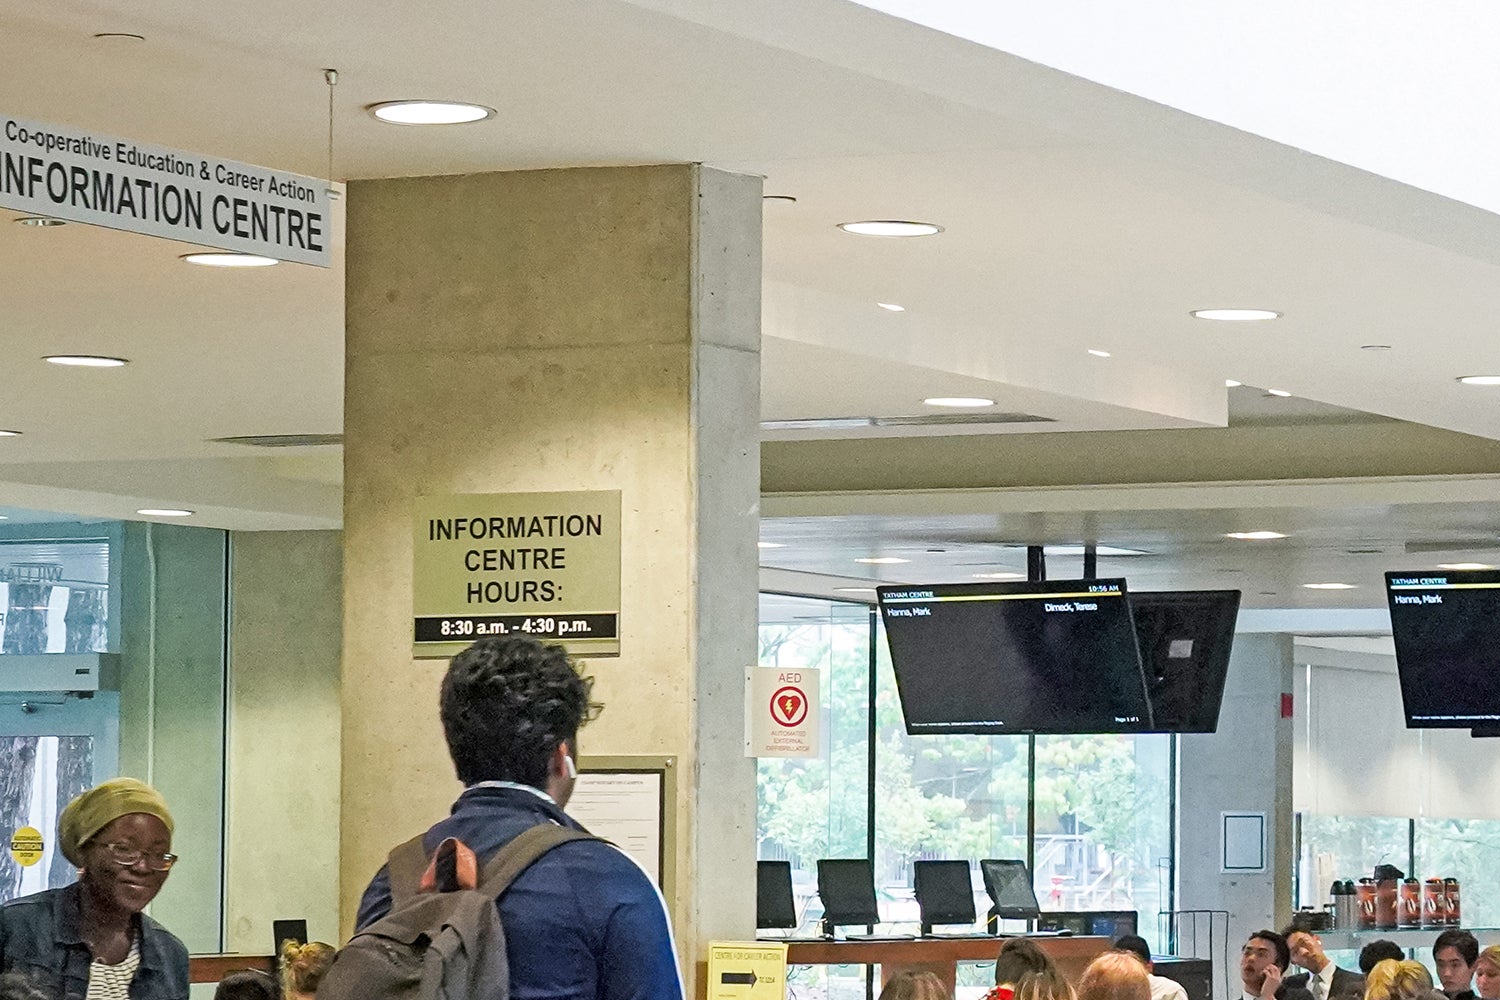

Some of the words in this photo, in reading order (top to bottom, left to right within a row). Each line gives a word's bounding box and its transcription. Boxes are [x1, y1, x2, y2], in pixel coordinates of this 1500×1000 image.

[6, 121, 110, 160] Co-operative
[117, 143, 194, 177] Education
[200, 161, 210, 180] &
[216, 165, 265, 192] Career
[269, 176, 315, 203] Action
[213, 195, 323, 252] CENTRE
[430, 514, 602, 540] INFORMATION
[465, 548, 565, 572] CENTRE
[468, 581, 563, 603] HOURS:
[441, 621, 473, 635] 8:30
[477, 622, 509, 635] a.m.
[522, 619, 554, 634] 4:30
[558, 621, 592, 636] p.m.
[779, 673, 802, 684] AED
